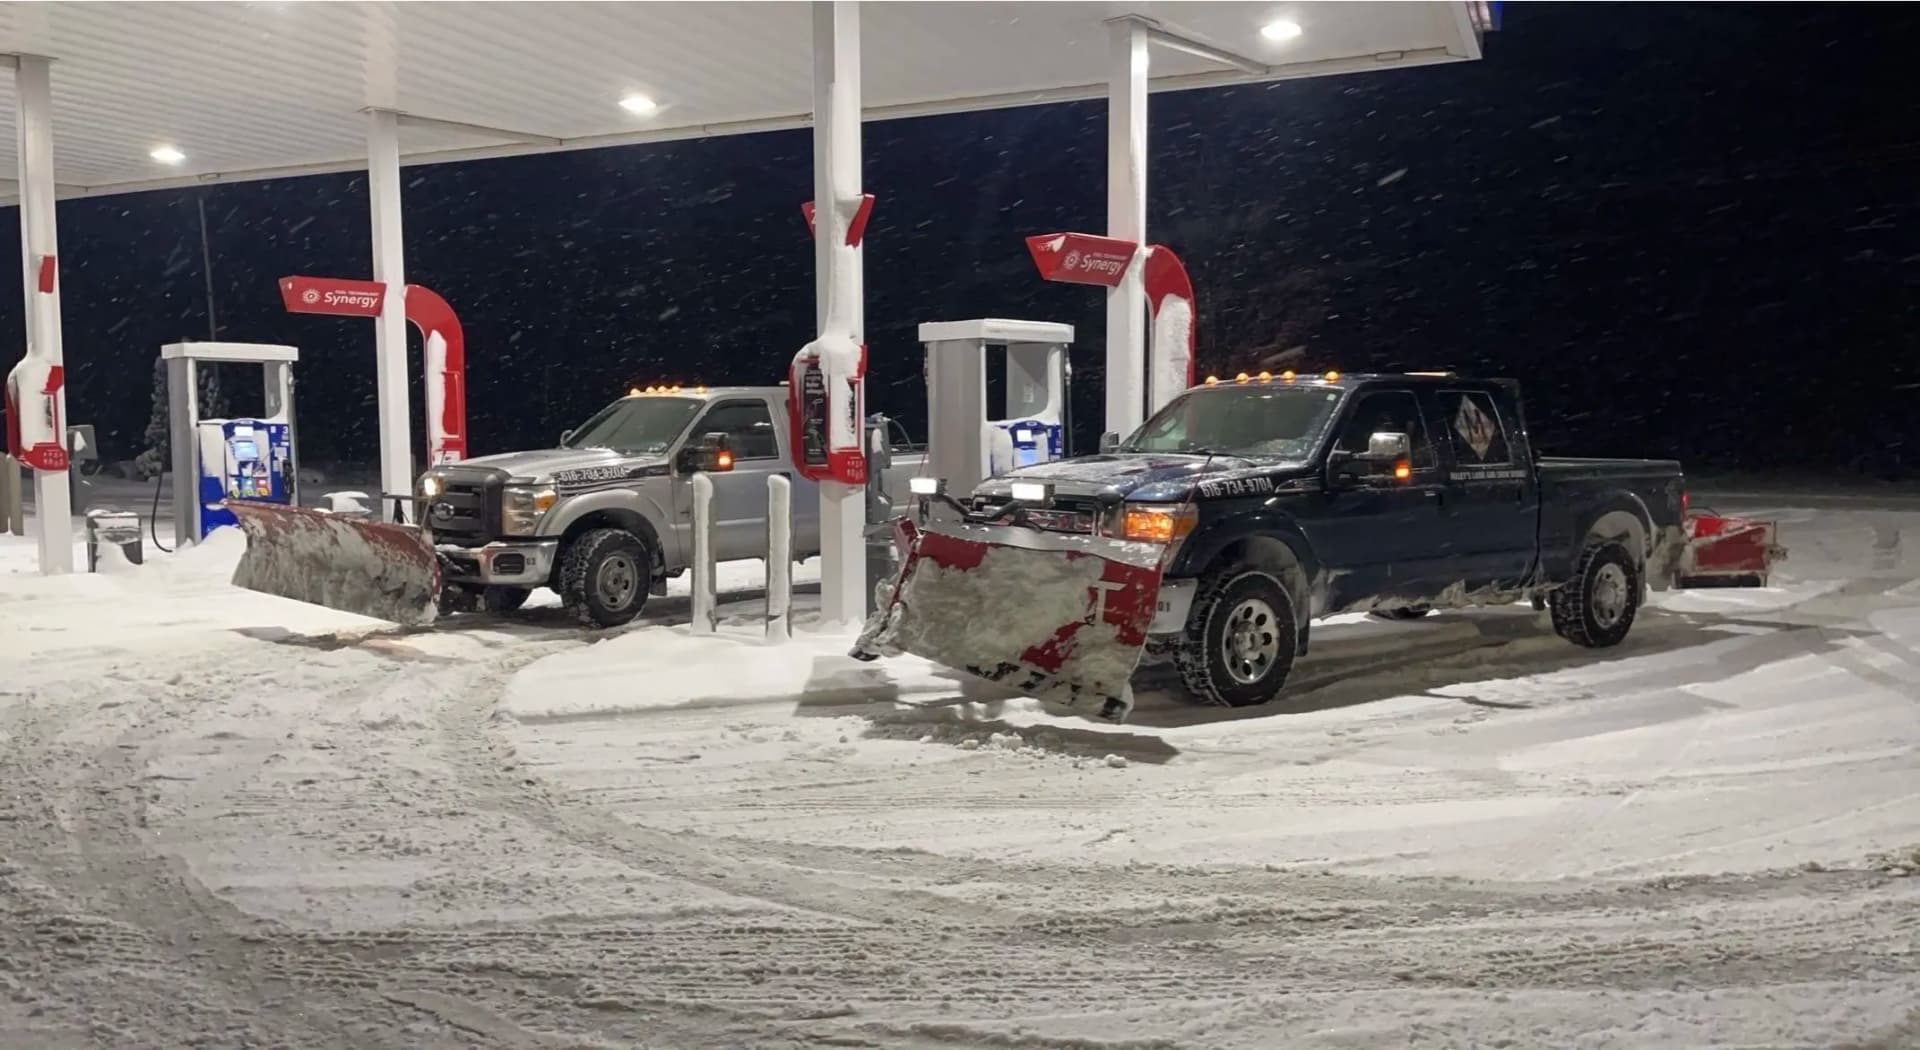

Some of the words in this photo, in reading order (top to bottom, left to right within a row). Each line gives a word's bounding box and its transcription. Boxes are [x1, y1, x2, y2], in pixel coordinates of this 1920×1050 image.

[1080, 254, 1124, 276] Synergy
[324, 291, 378, 308] Synergy
[1200, 476, 1274, 498] 616-734-9704
